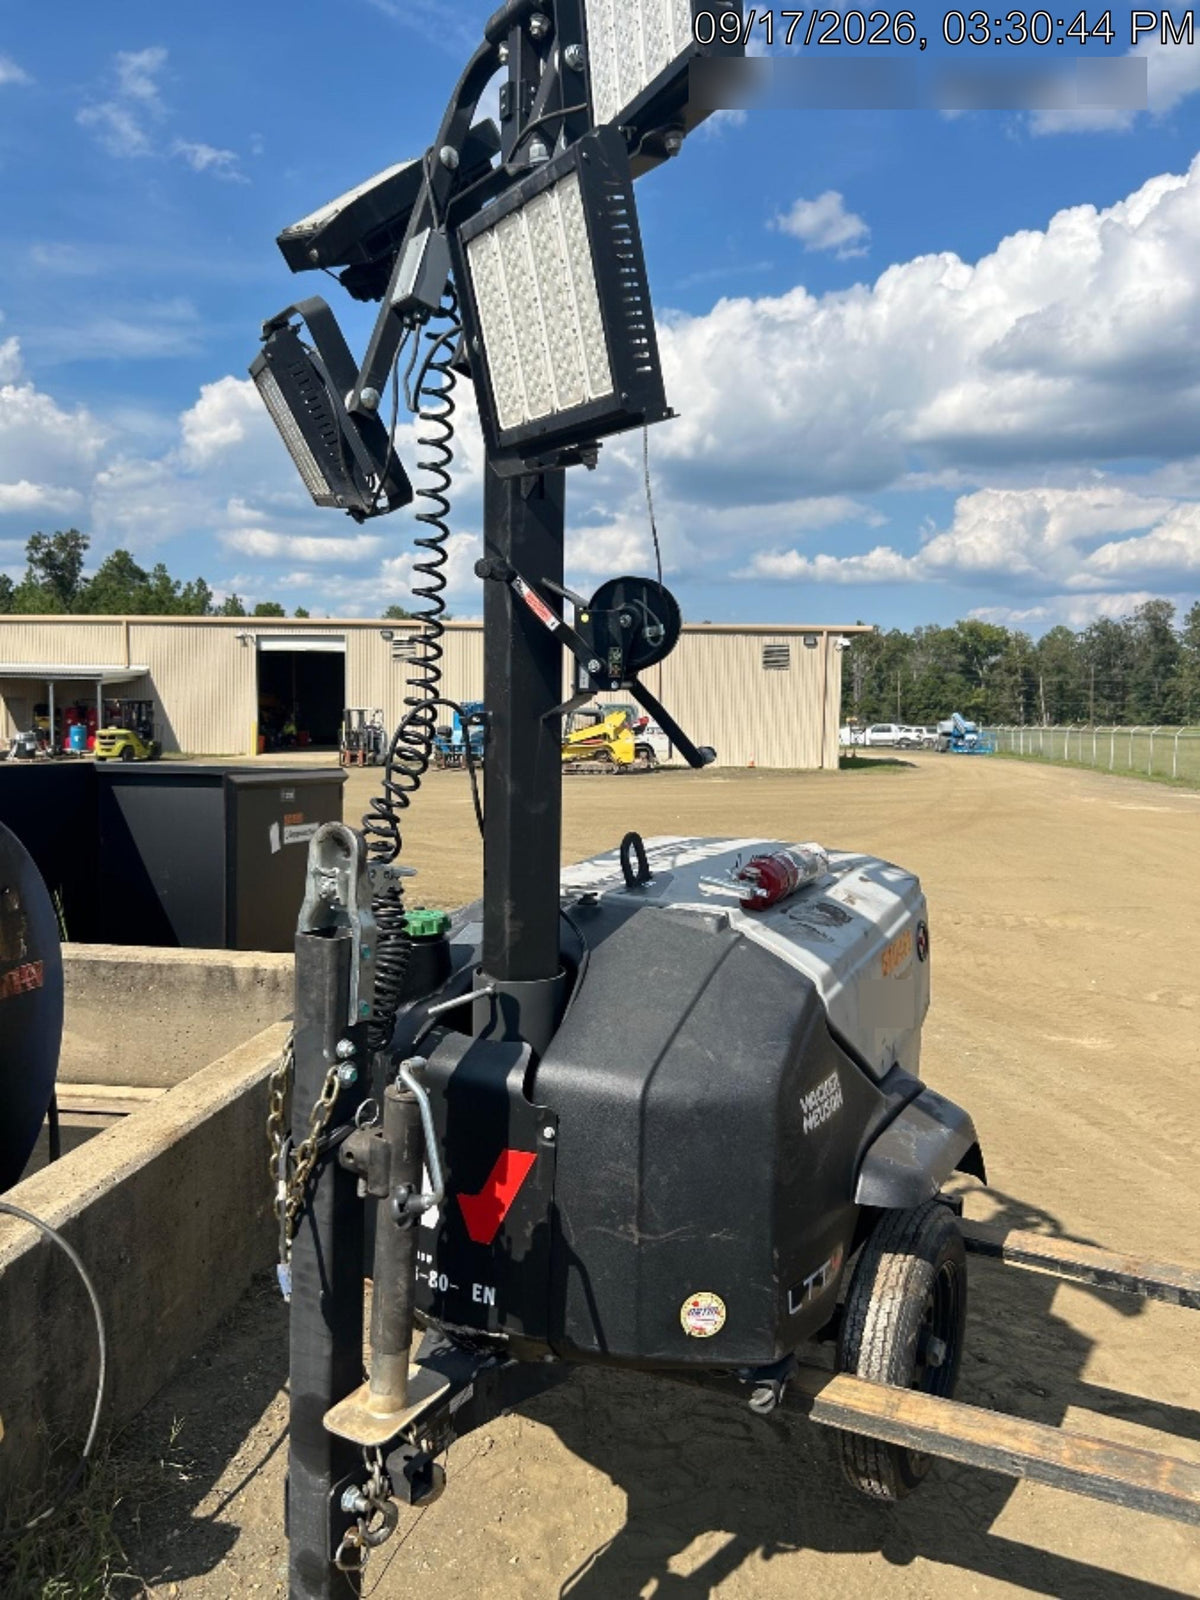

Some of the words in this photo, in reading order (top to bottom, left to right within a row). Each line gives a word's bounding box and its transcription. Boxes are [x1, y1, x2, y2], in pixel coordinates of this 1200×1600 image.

[800, 1072, 840, 1114] WACKER
[803, 1088, 843, 1135] NEUSON
[472, 1282, 496, 1306] EN
